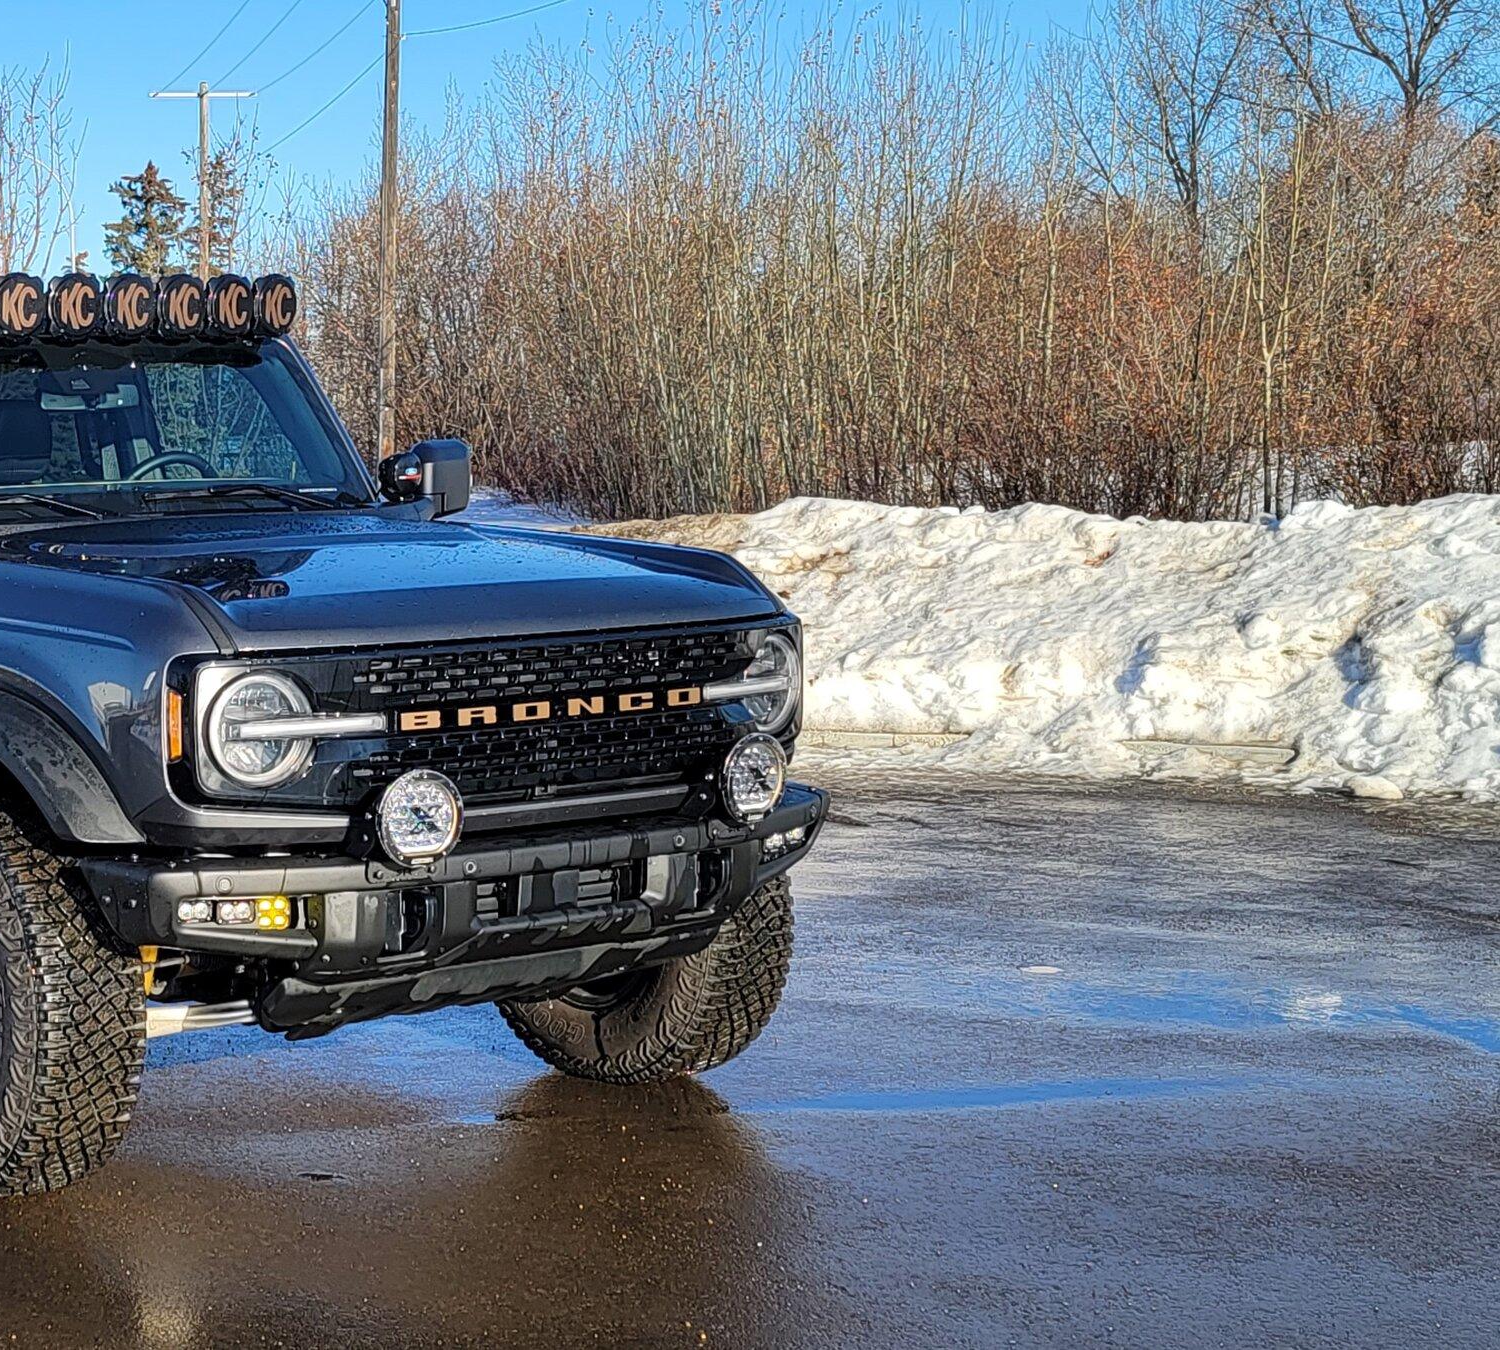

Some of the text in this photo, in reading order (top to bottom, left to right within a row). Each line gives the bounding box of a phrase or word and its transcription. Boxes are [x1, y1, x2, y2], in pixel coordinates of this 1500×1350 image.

[1, 283, 38, 331] KC
[59, 282, 96, 328] KC
[116, 283, 150, 328] KC
[169, 284, 201, 327] KC
[218, 284, 248, 326] KC
[264, 285, 292, 326] KC
[400, 687, 701, 731] BRONCO
